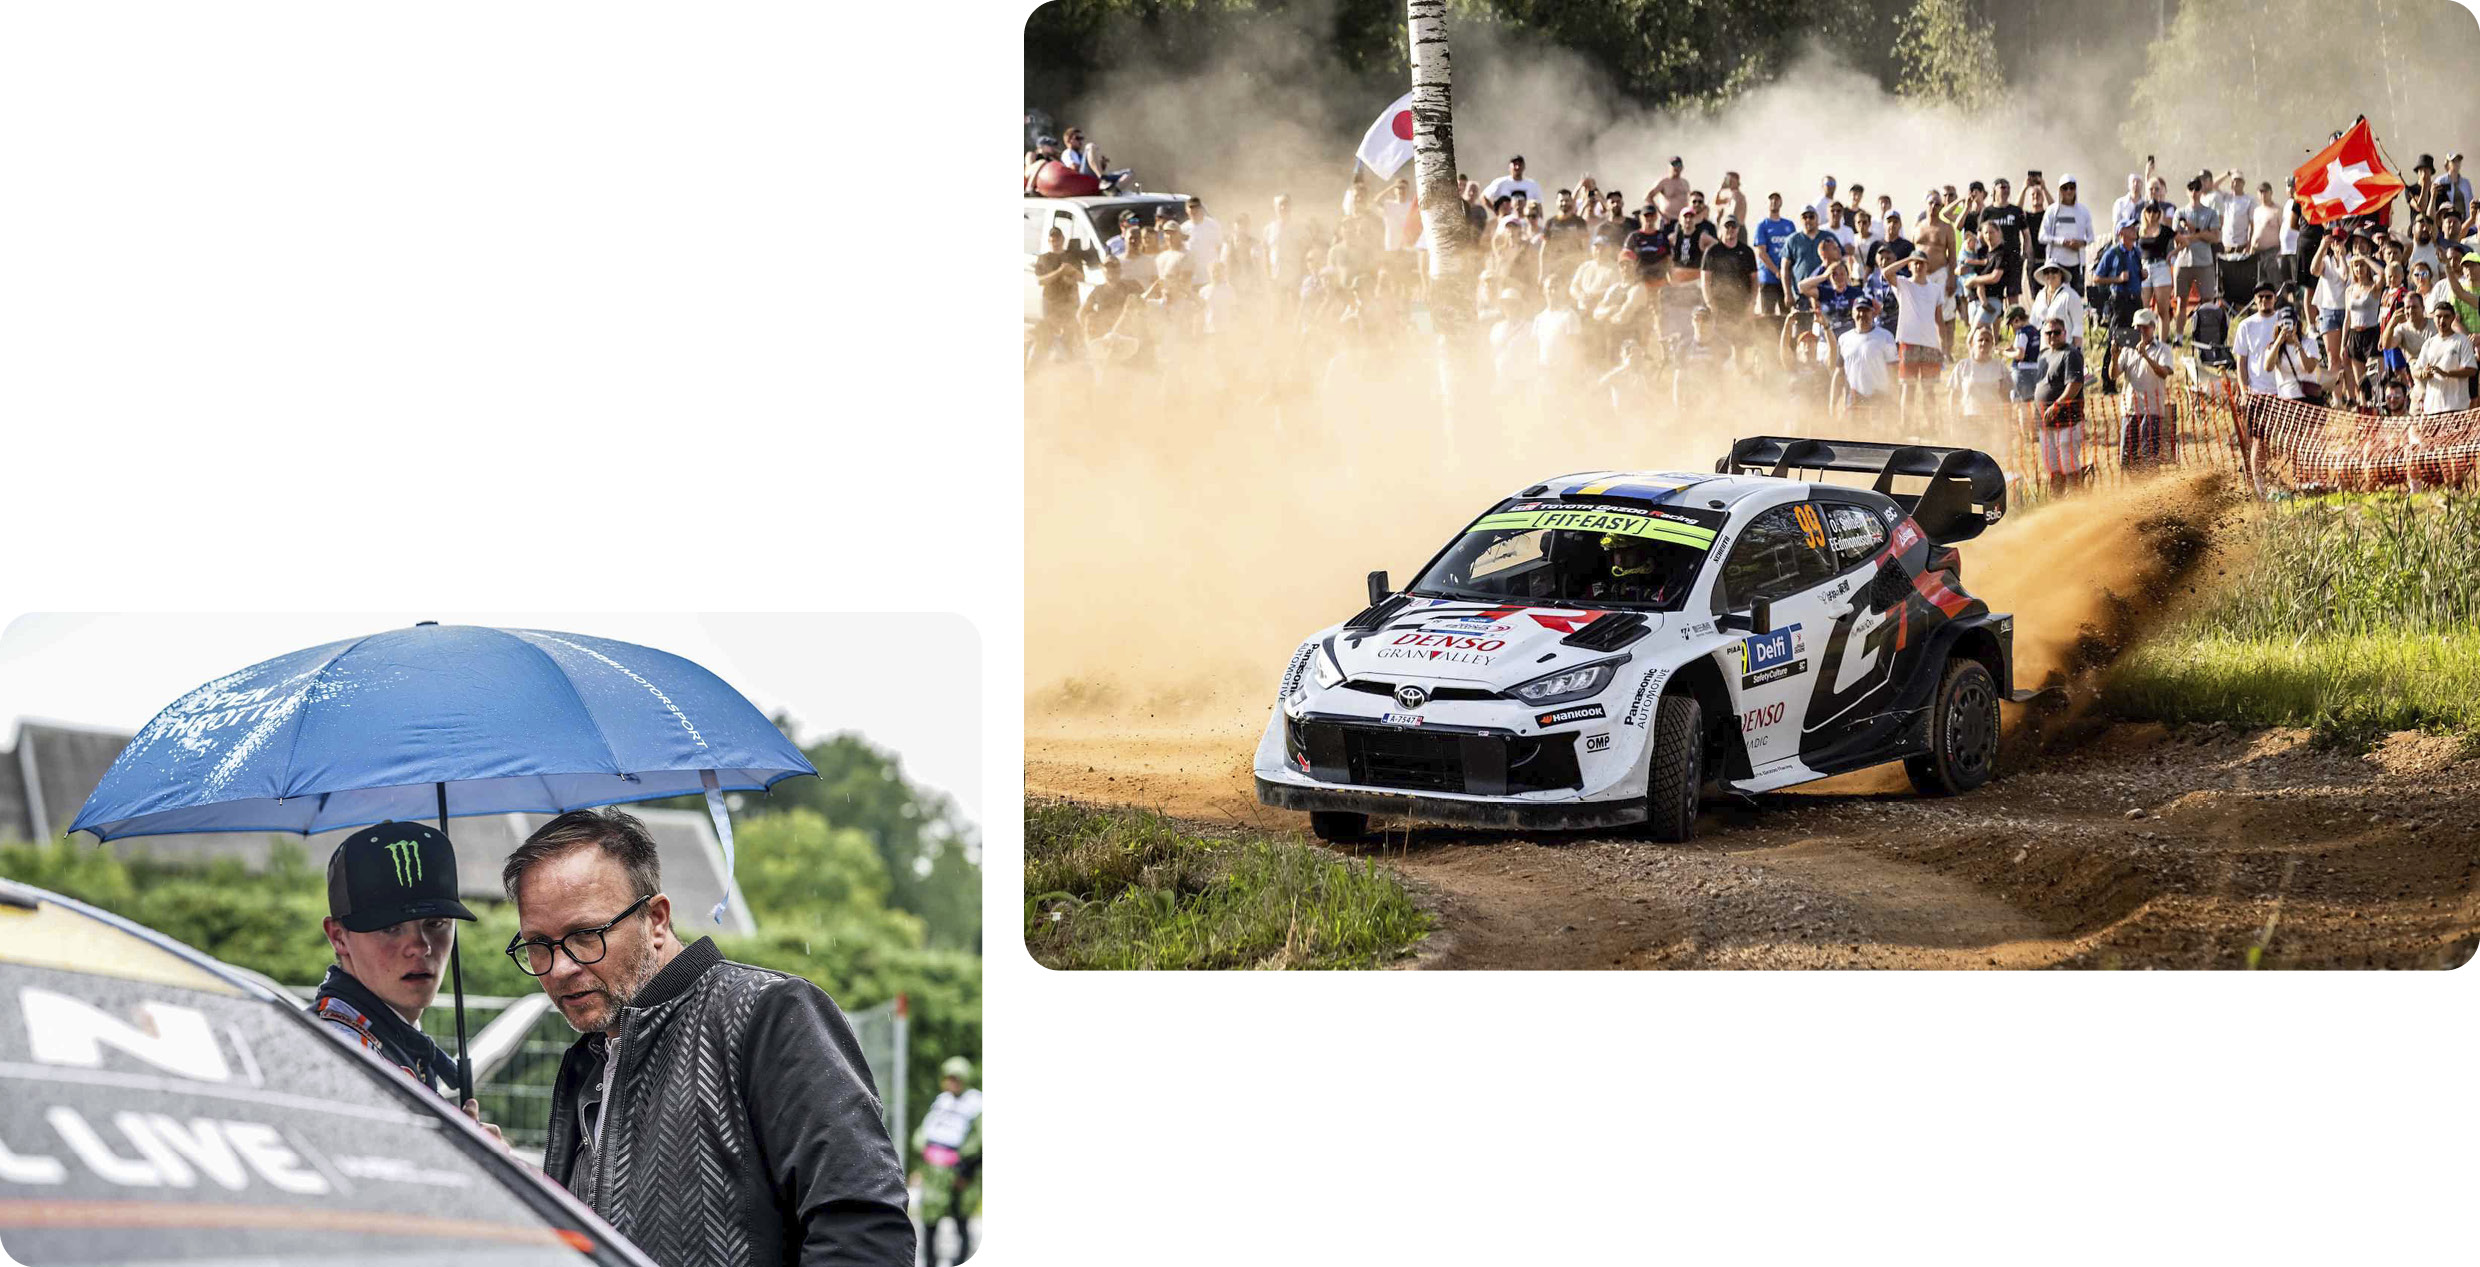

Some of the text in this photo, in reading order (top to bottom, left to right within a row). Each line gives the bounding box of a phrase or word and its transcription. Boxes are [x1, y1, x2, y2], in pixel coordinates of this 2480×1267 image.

[1540, 503, 1595, 512] TOYOTA
[1597, 504, 1650, 516] GAZOO
[1650, 510, 1700, 525] Racing
[1793, 504, 1826, 550] 99
[1392, 633, 1507, 652] DENSO
[1756, 635, 1787, 663] Delfi
[1278, 642, 1310, 703] AUTOMOTIVE
[1752, 667, 1788, 685] SafetyCulture
[183, 685, 279, 714] OPEN
[1624, 667, 1658, 726] Panasonic
[1637, 668, 1671, 730] AUTOMOTIVE
[1586, 735, 1610, 750] OMP
[46, 1104, 331, 1196] LIVE
